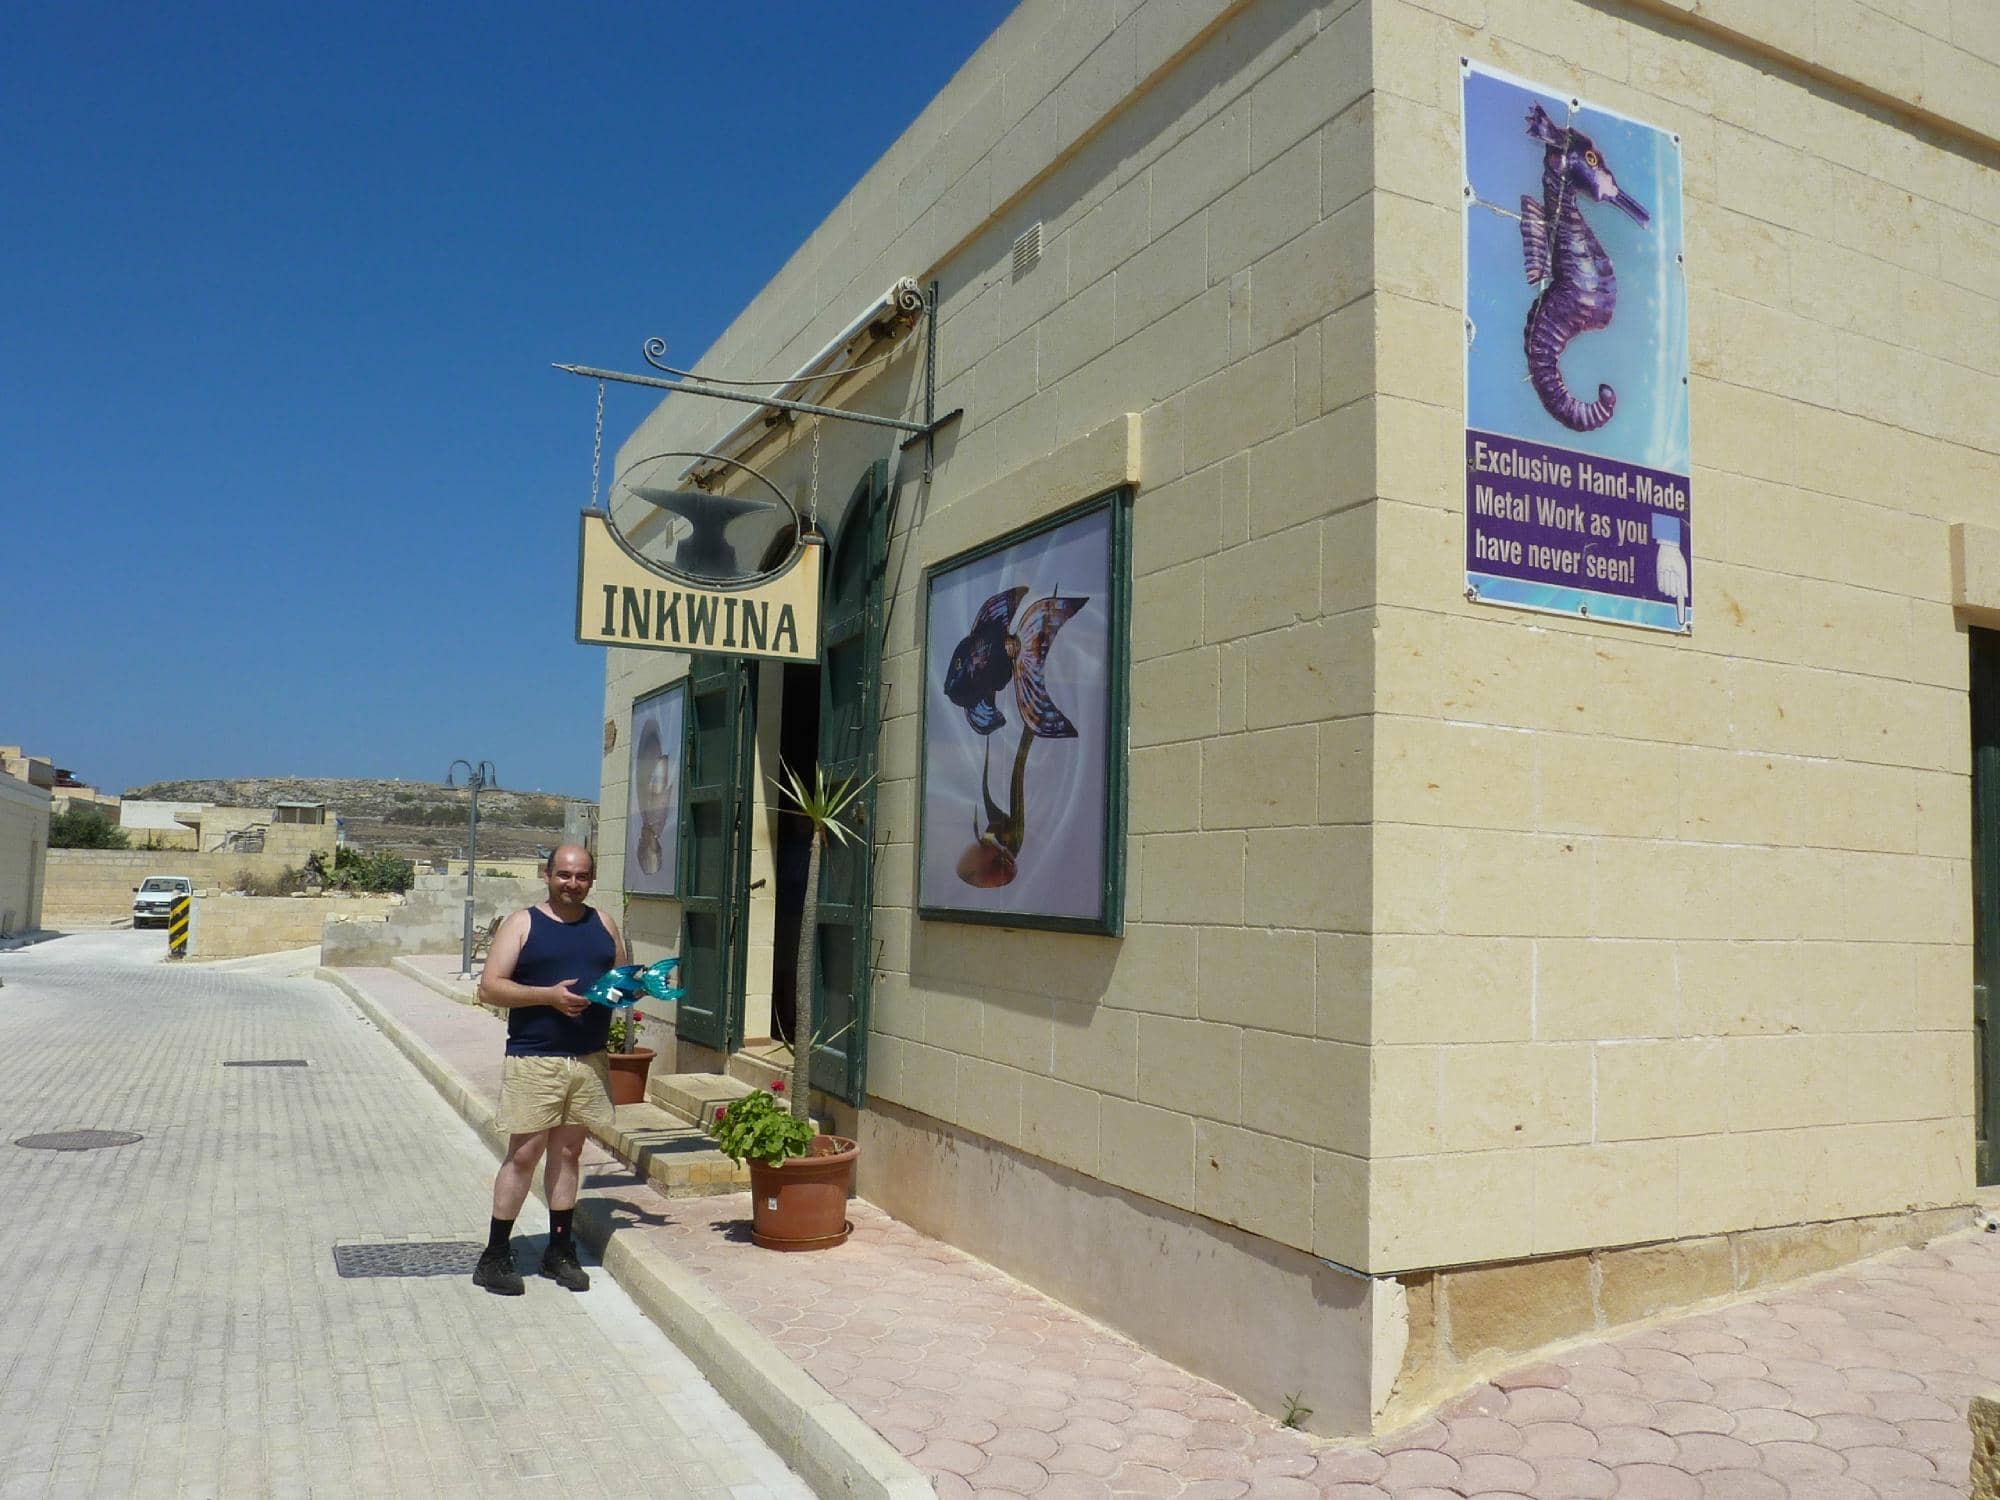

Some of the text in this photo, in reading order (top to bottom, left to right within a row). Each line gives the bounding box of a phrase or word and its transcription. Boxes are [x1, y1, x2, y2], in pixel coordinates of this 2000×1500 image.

[1475, 441, 1685, 512] Exclusive Hand-Made
[1475, 485, 1648, 547] Metal Work as you
[1475, 529, 1635, 584] have never seen!
[601, 584, 799, 653] INKWINA
